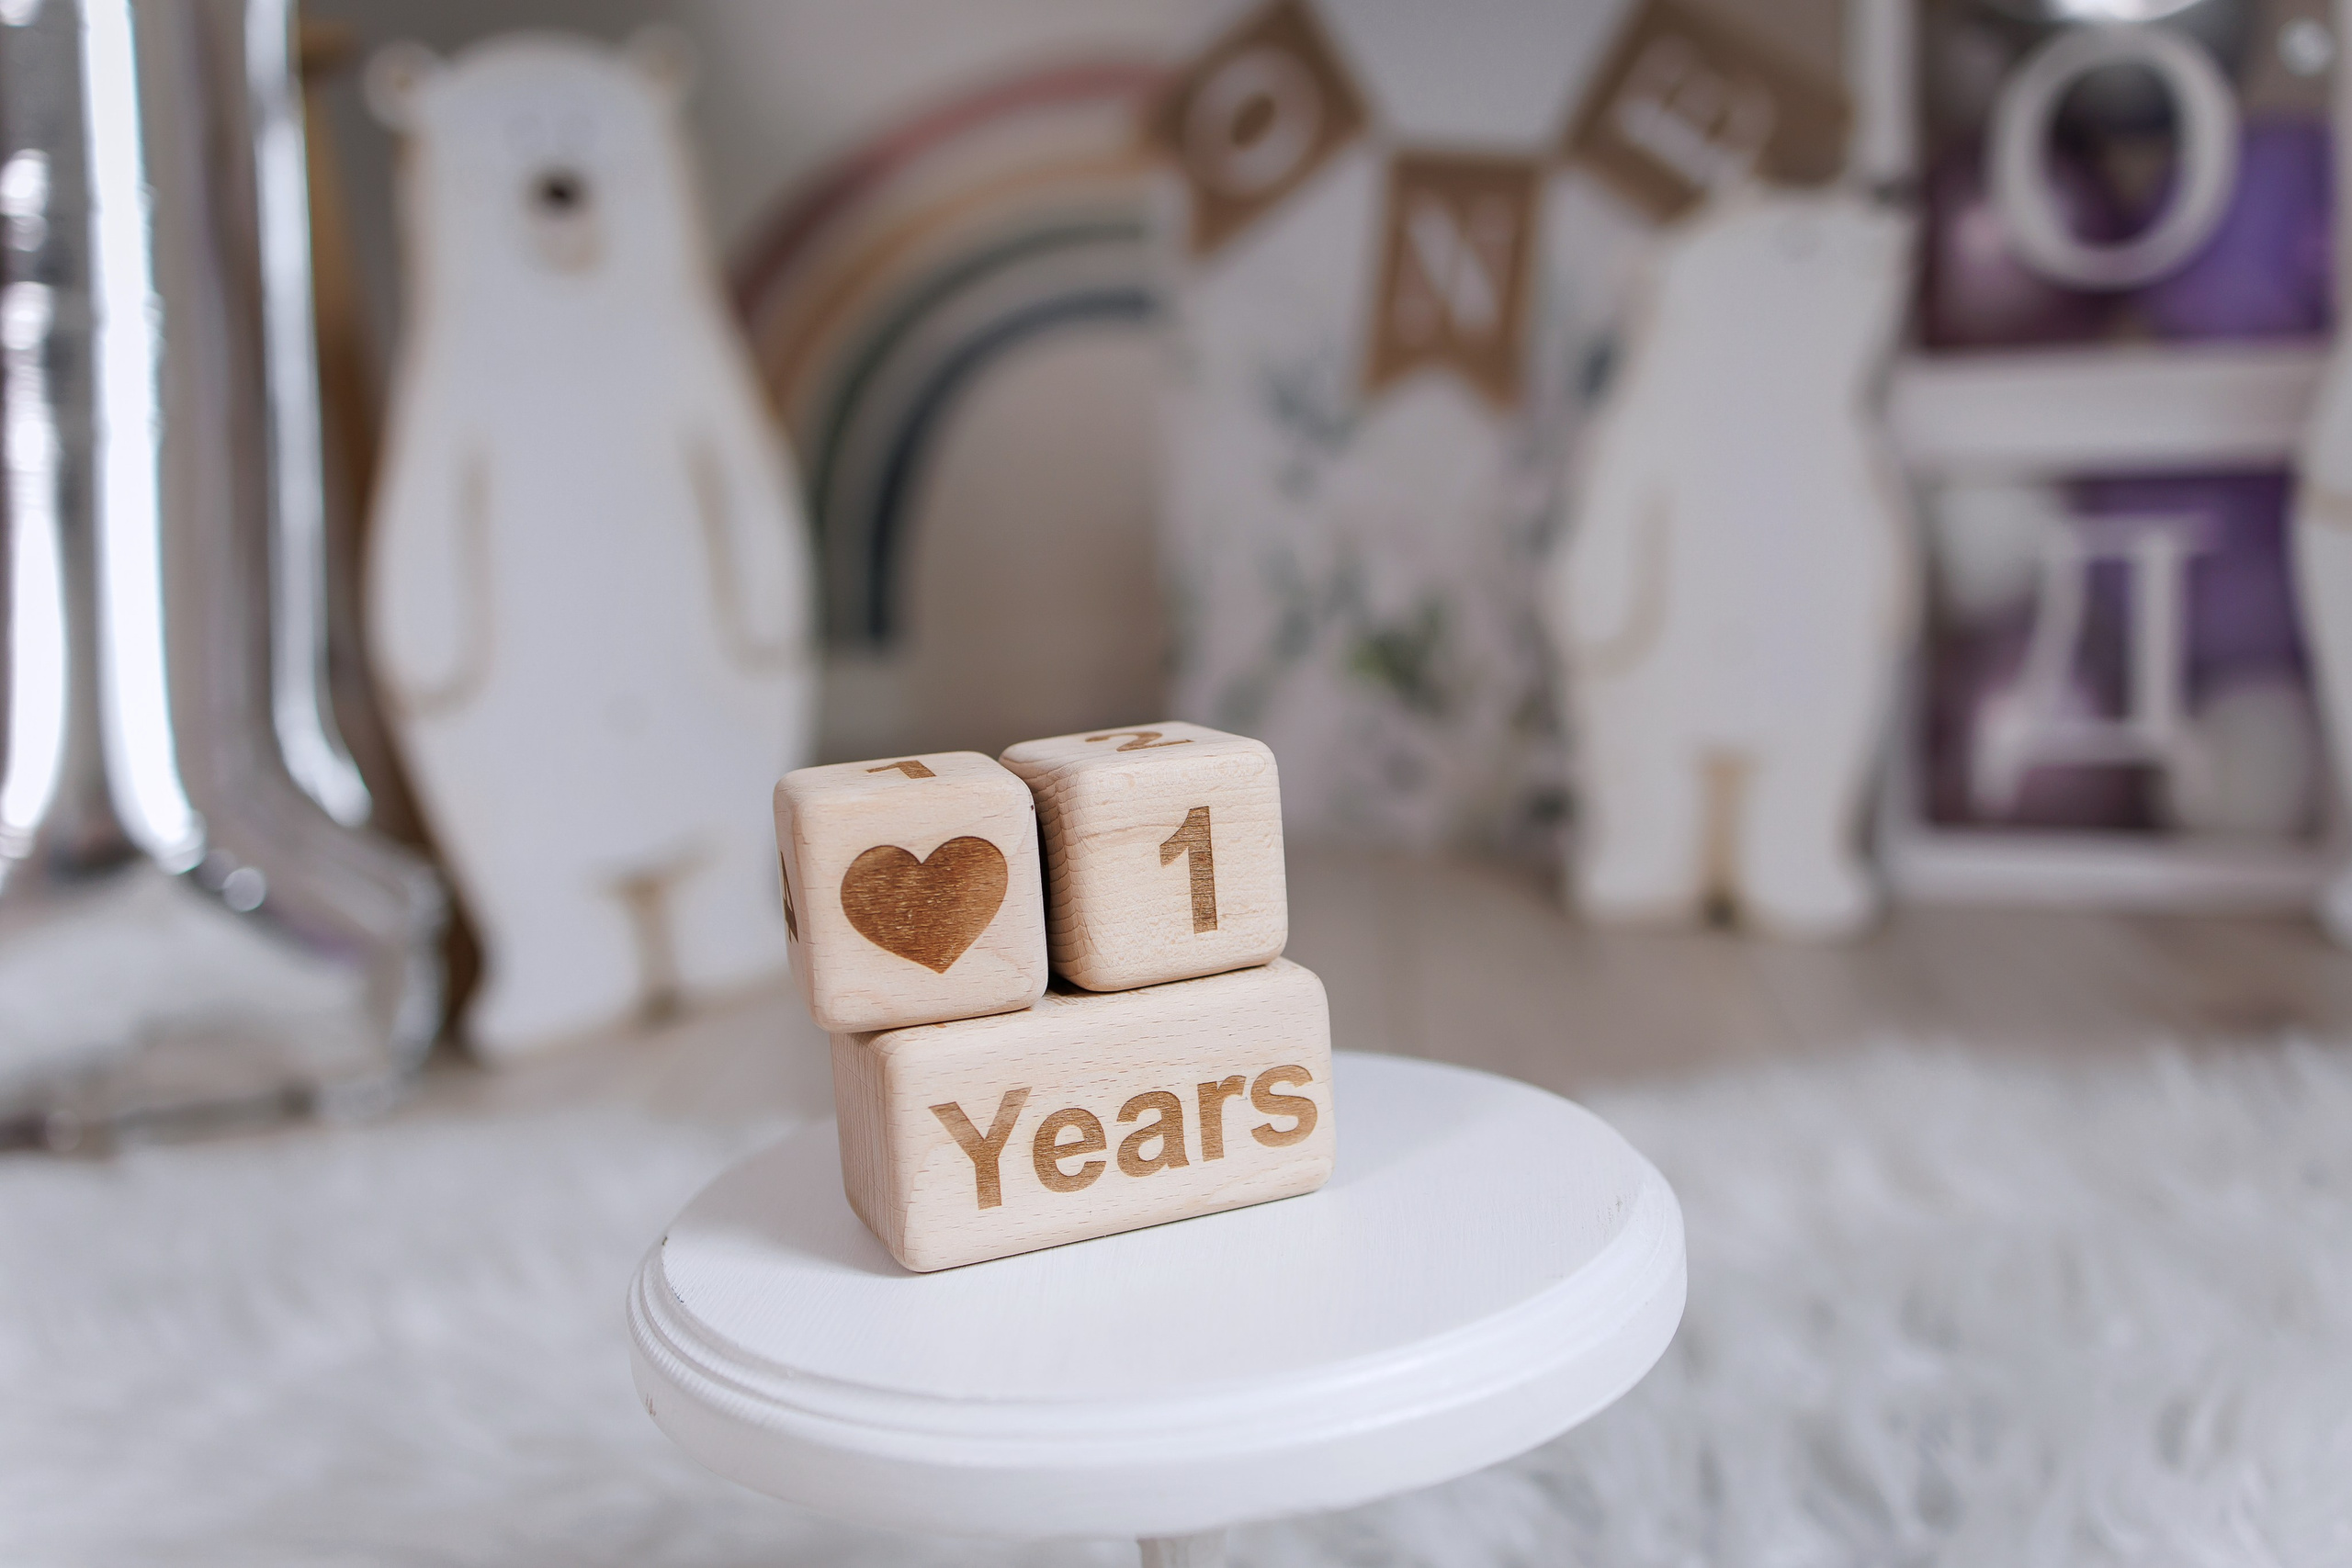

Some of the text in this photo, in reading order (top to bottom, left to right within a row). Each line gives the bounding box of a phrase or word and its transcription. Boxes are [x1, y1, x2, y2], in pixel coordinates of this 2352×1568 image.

[1084, 731, 1194, 752] 2
[1159, 805, 1218, 934] 1
[928, 1064, 1318, 1211] Years
